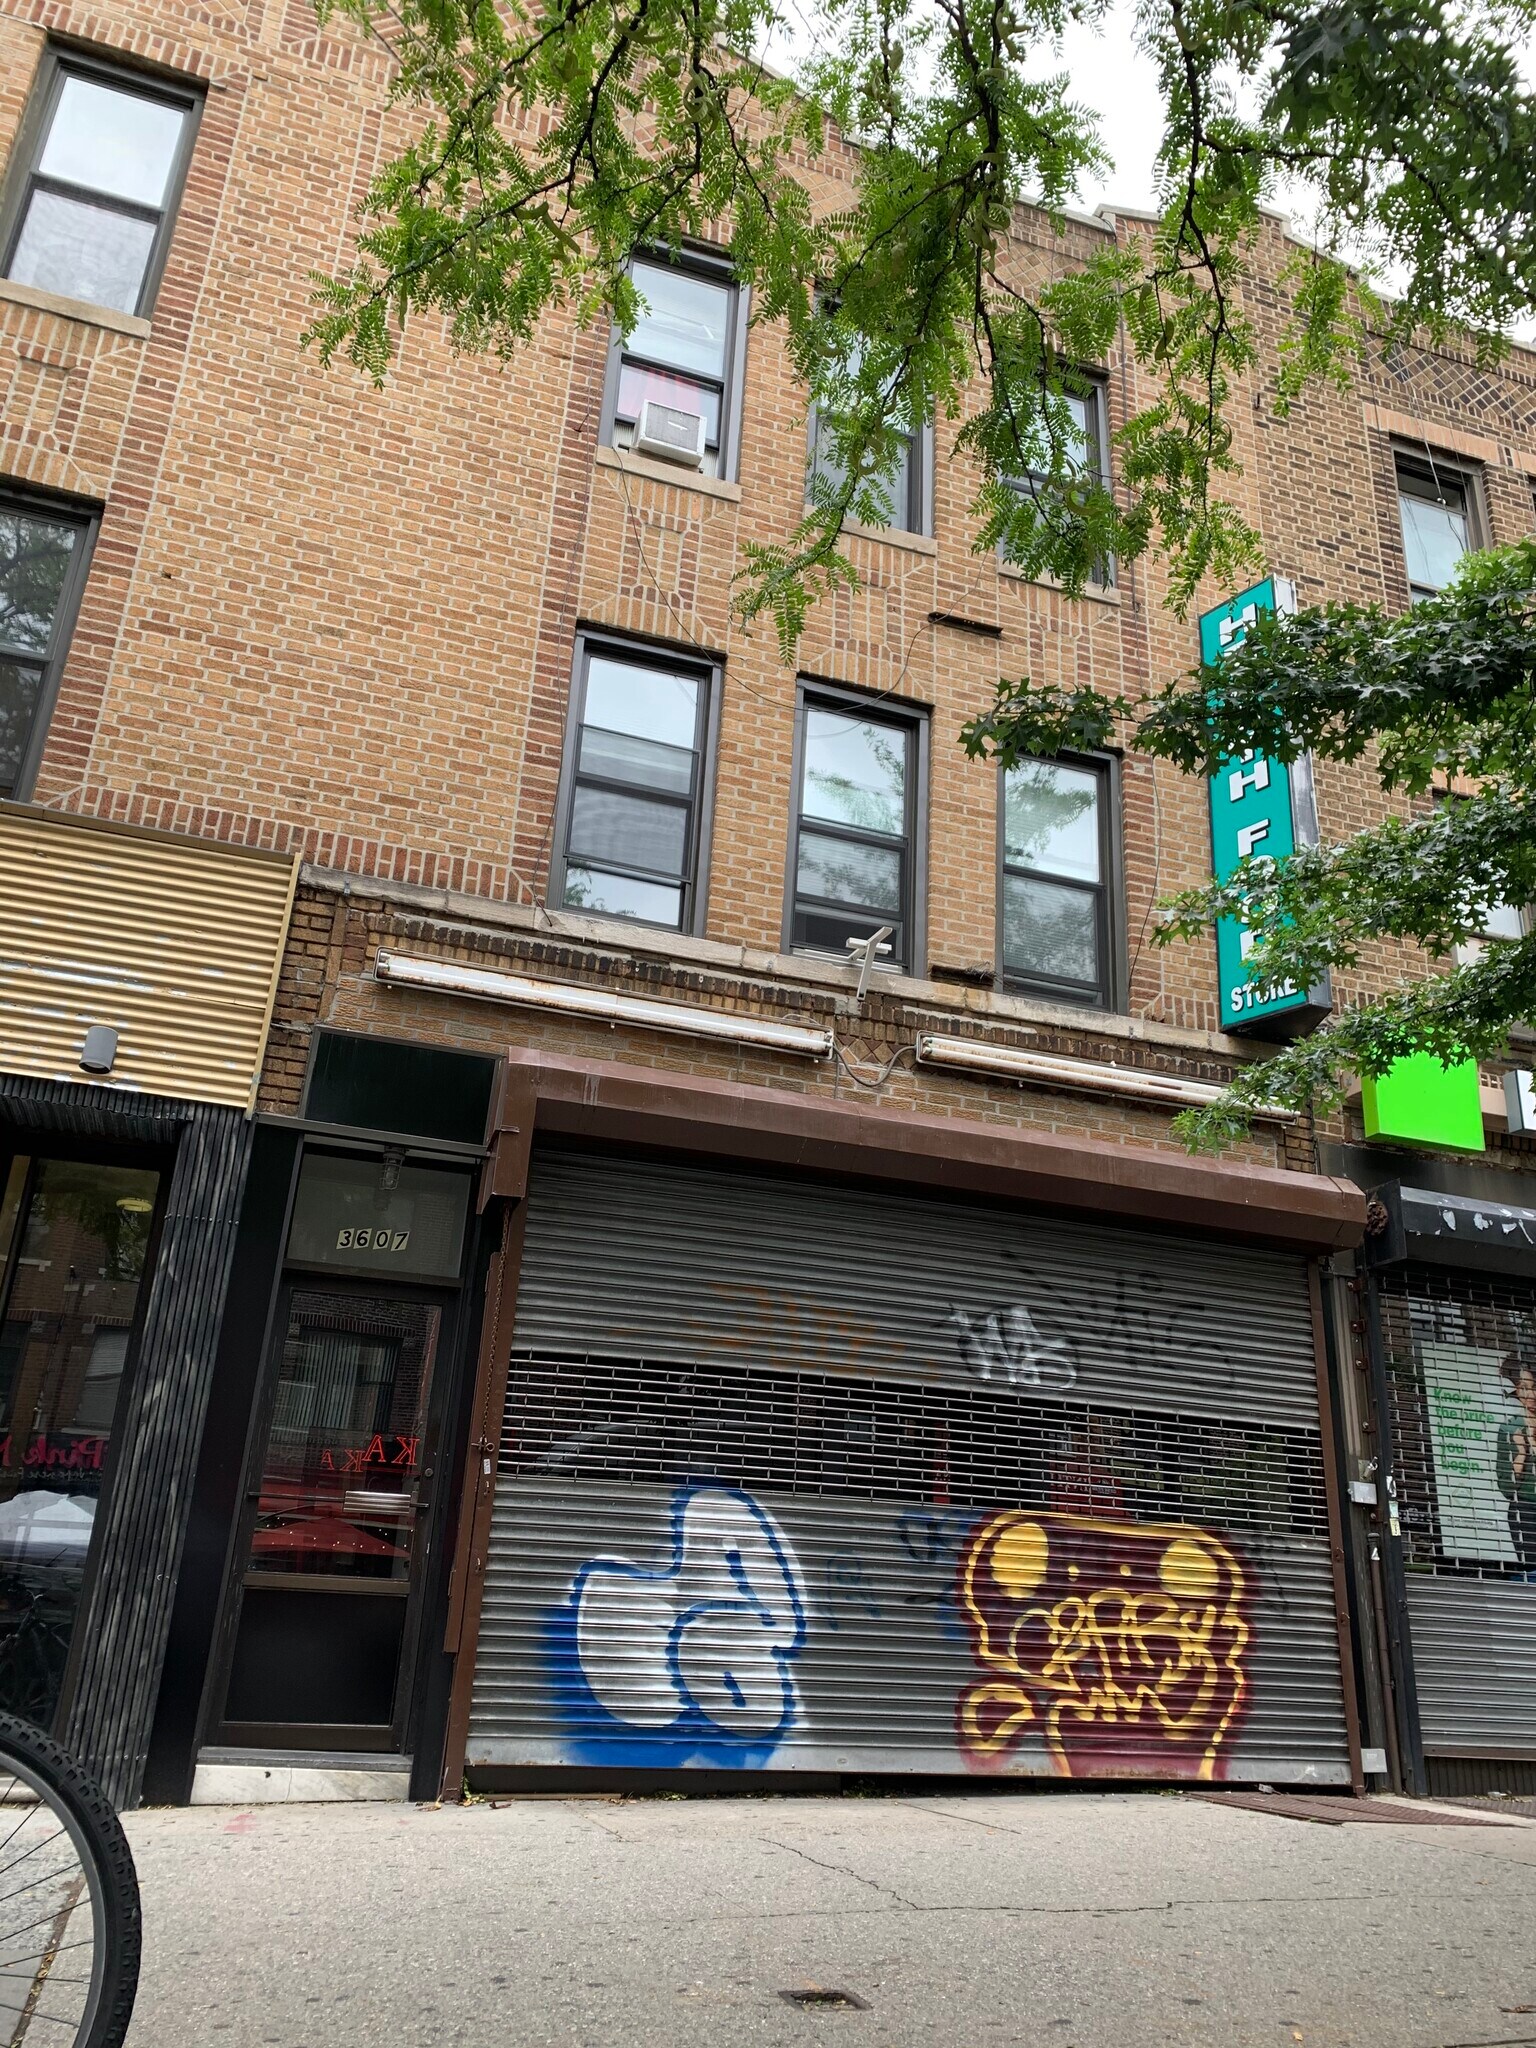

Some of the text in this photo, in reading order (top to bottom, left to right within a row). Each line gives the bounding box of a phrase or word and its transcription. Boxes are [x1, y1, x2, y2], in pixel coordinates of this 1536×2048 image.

[339, 1230, 408, 1250] 3607
[1433, 1387, 1472, 1405] Know
[1435, 1405, 1458, 1420] the
[1437, 1421, 1483, 1441] before
[1439, 1440, 1465, 1456] you
